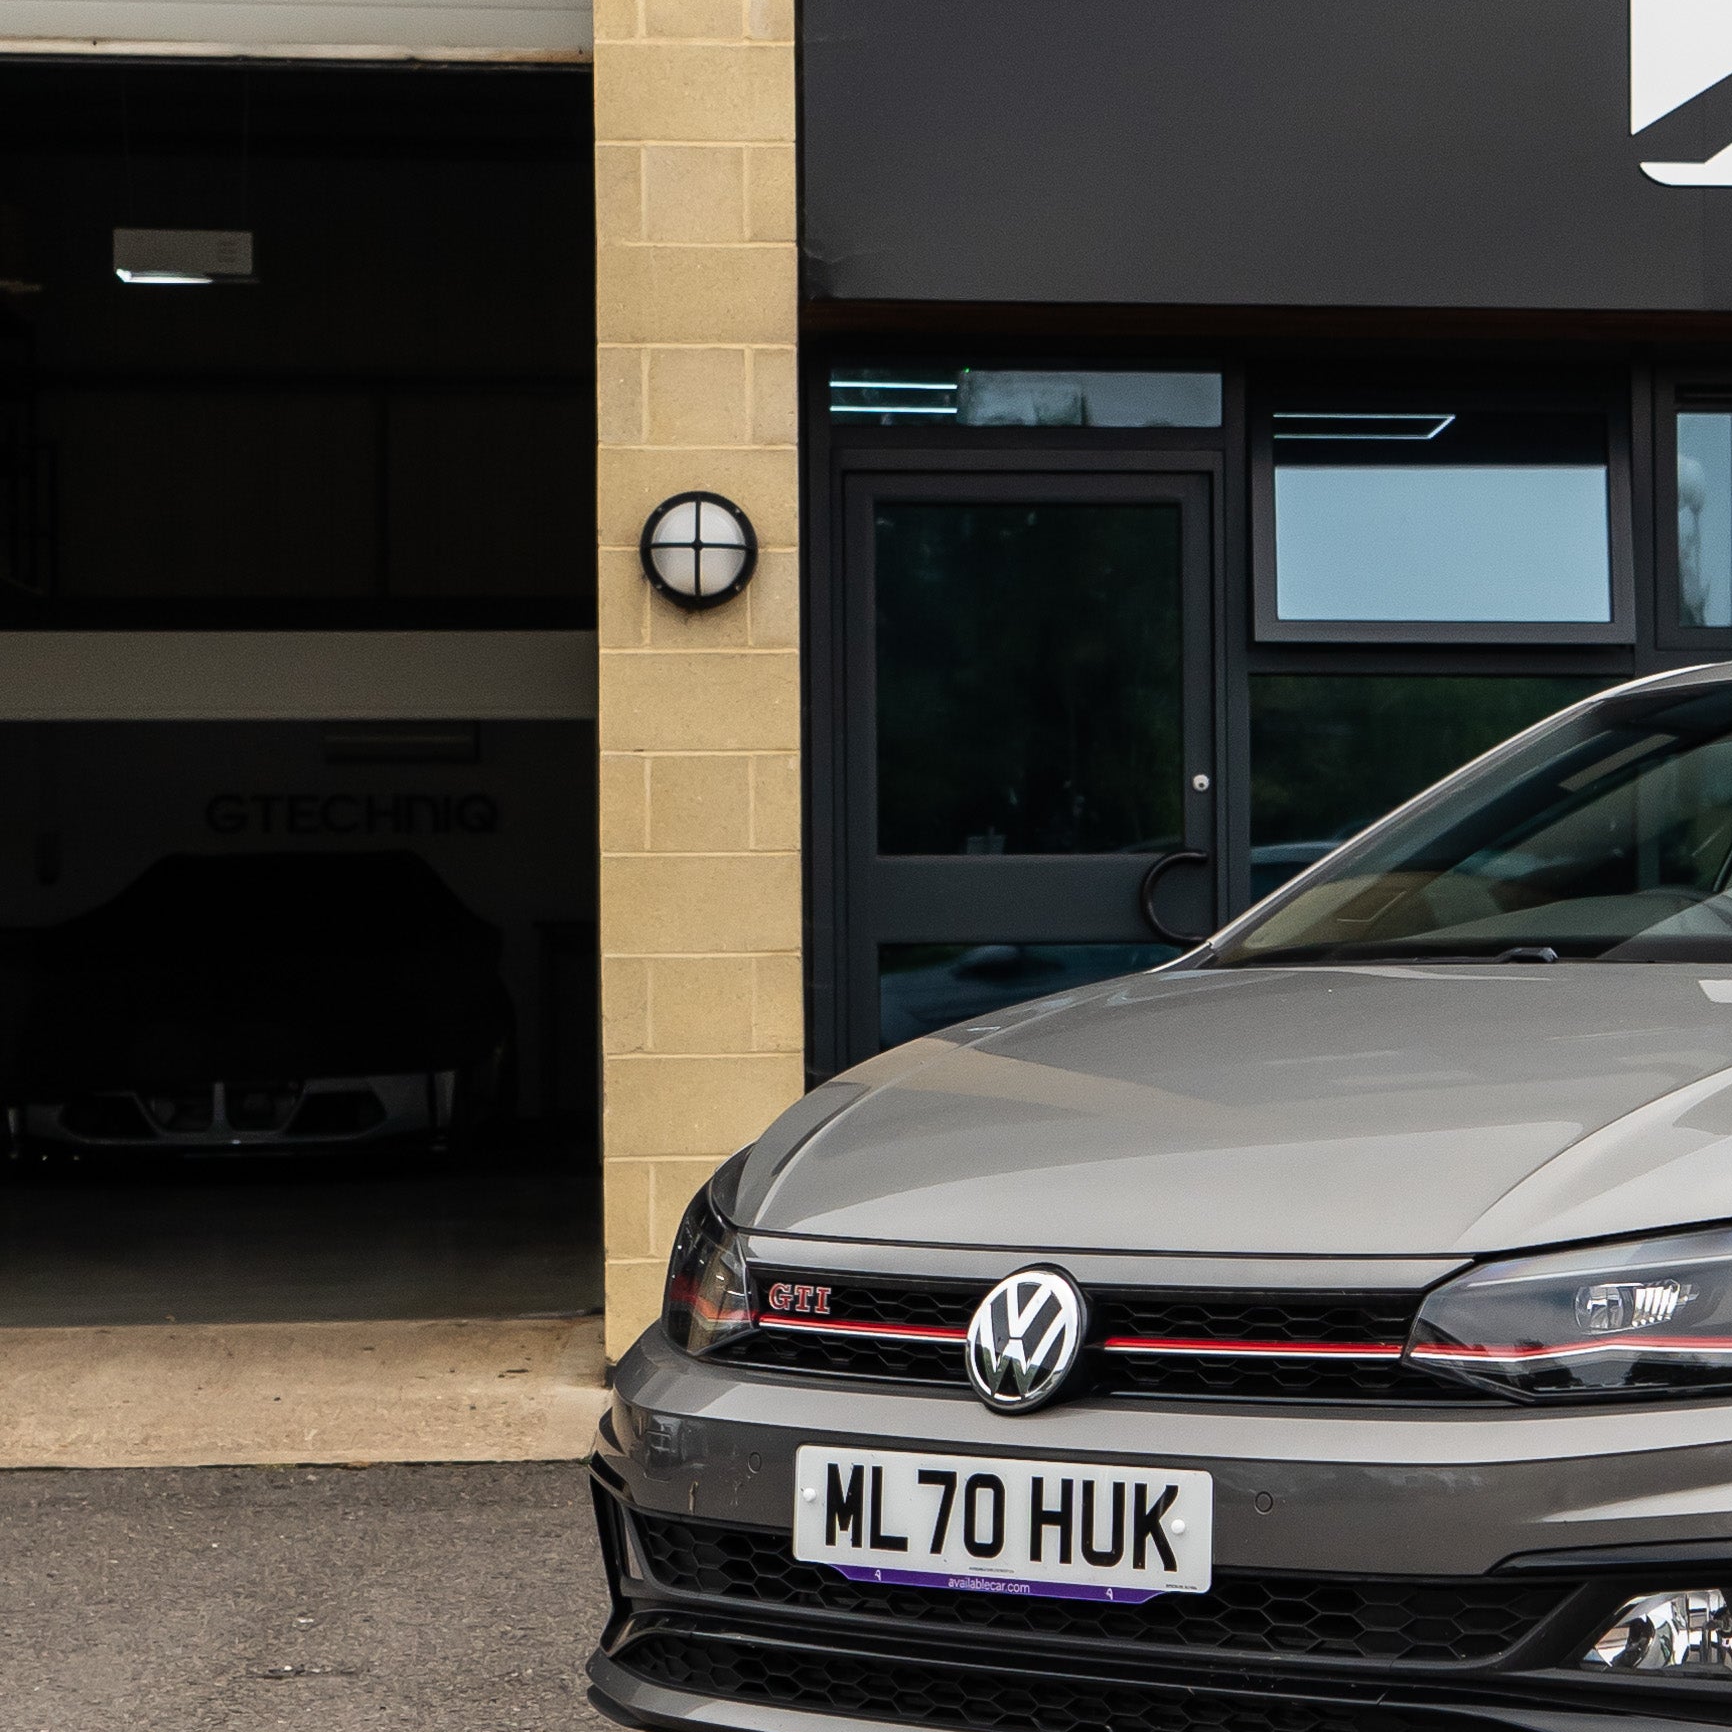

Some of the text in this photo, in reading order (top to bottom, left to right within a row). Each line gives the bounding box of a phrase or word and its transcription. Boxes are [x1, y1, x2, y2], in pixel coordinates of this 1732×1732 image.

[769, 1282, 832, 1315] GTI
[826, 1463, 1179, 1572] ML70 HUK
[948, 1577, 1030, 1594] availablecar.com
